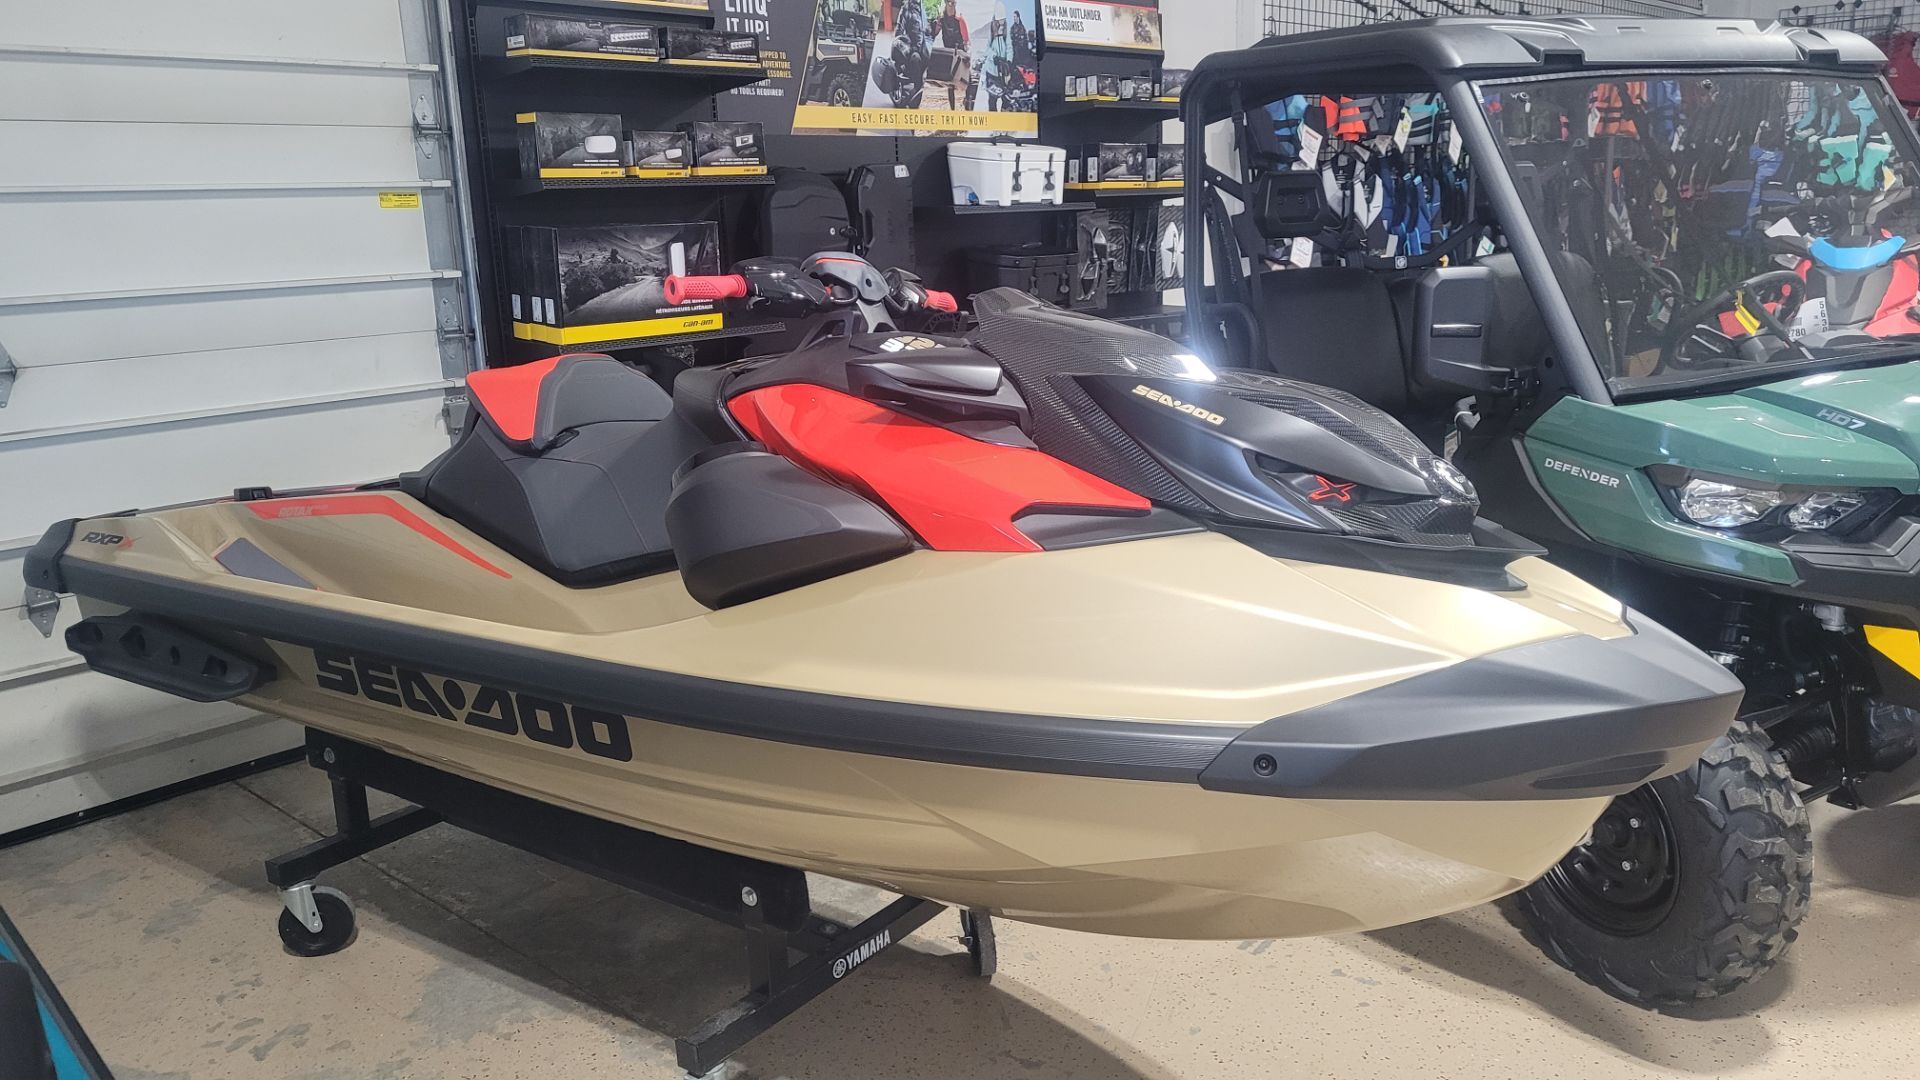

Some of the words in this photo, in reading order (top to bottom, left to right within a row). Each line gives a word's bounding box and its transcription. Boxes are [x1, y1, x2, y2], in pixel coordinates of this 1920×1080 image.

[1044, 5, 1068, 18] CAN-AM
[1069, 8, 1102, 21] OUTLANDER
[726, 17, 740, 32] IT
[745, 18, 770, 40] UP!
[1046, 18, 1085, 33] ACCESSORIES
[851, 112, 876, 124] EASY.
[879, 113, 901, 125] FAST.
[904, 114, 938, 125] SECURE.
[941, 115, 955, 125] TRY
[958, 116, 966, 126] IT
[968, 116, 988, 126] NOW!
[1815, 408, 1867, 430] HD7
[1543, 457, 1620, 489] DEFENDER
[846, 929, 892, 970] YAMAHA
